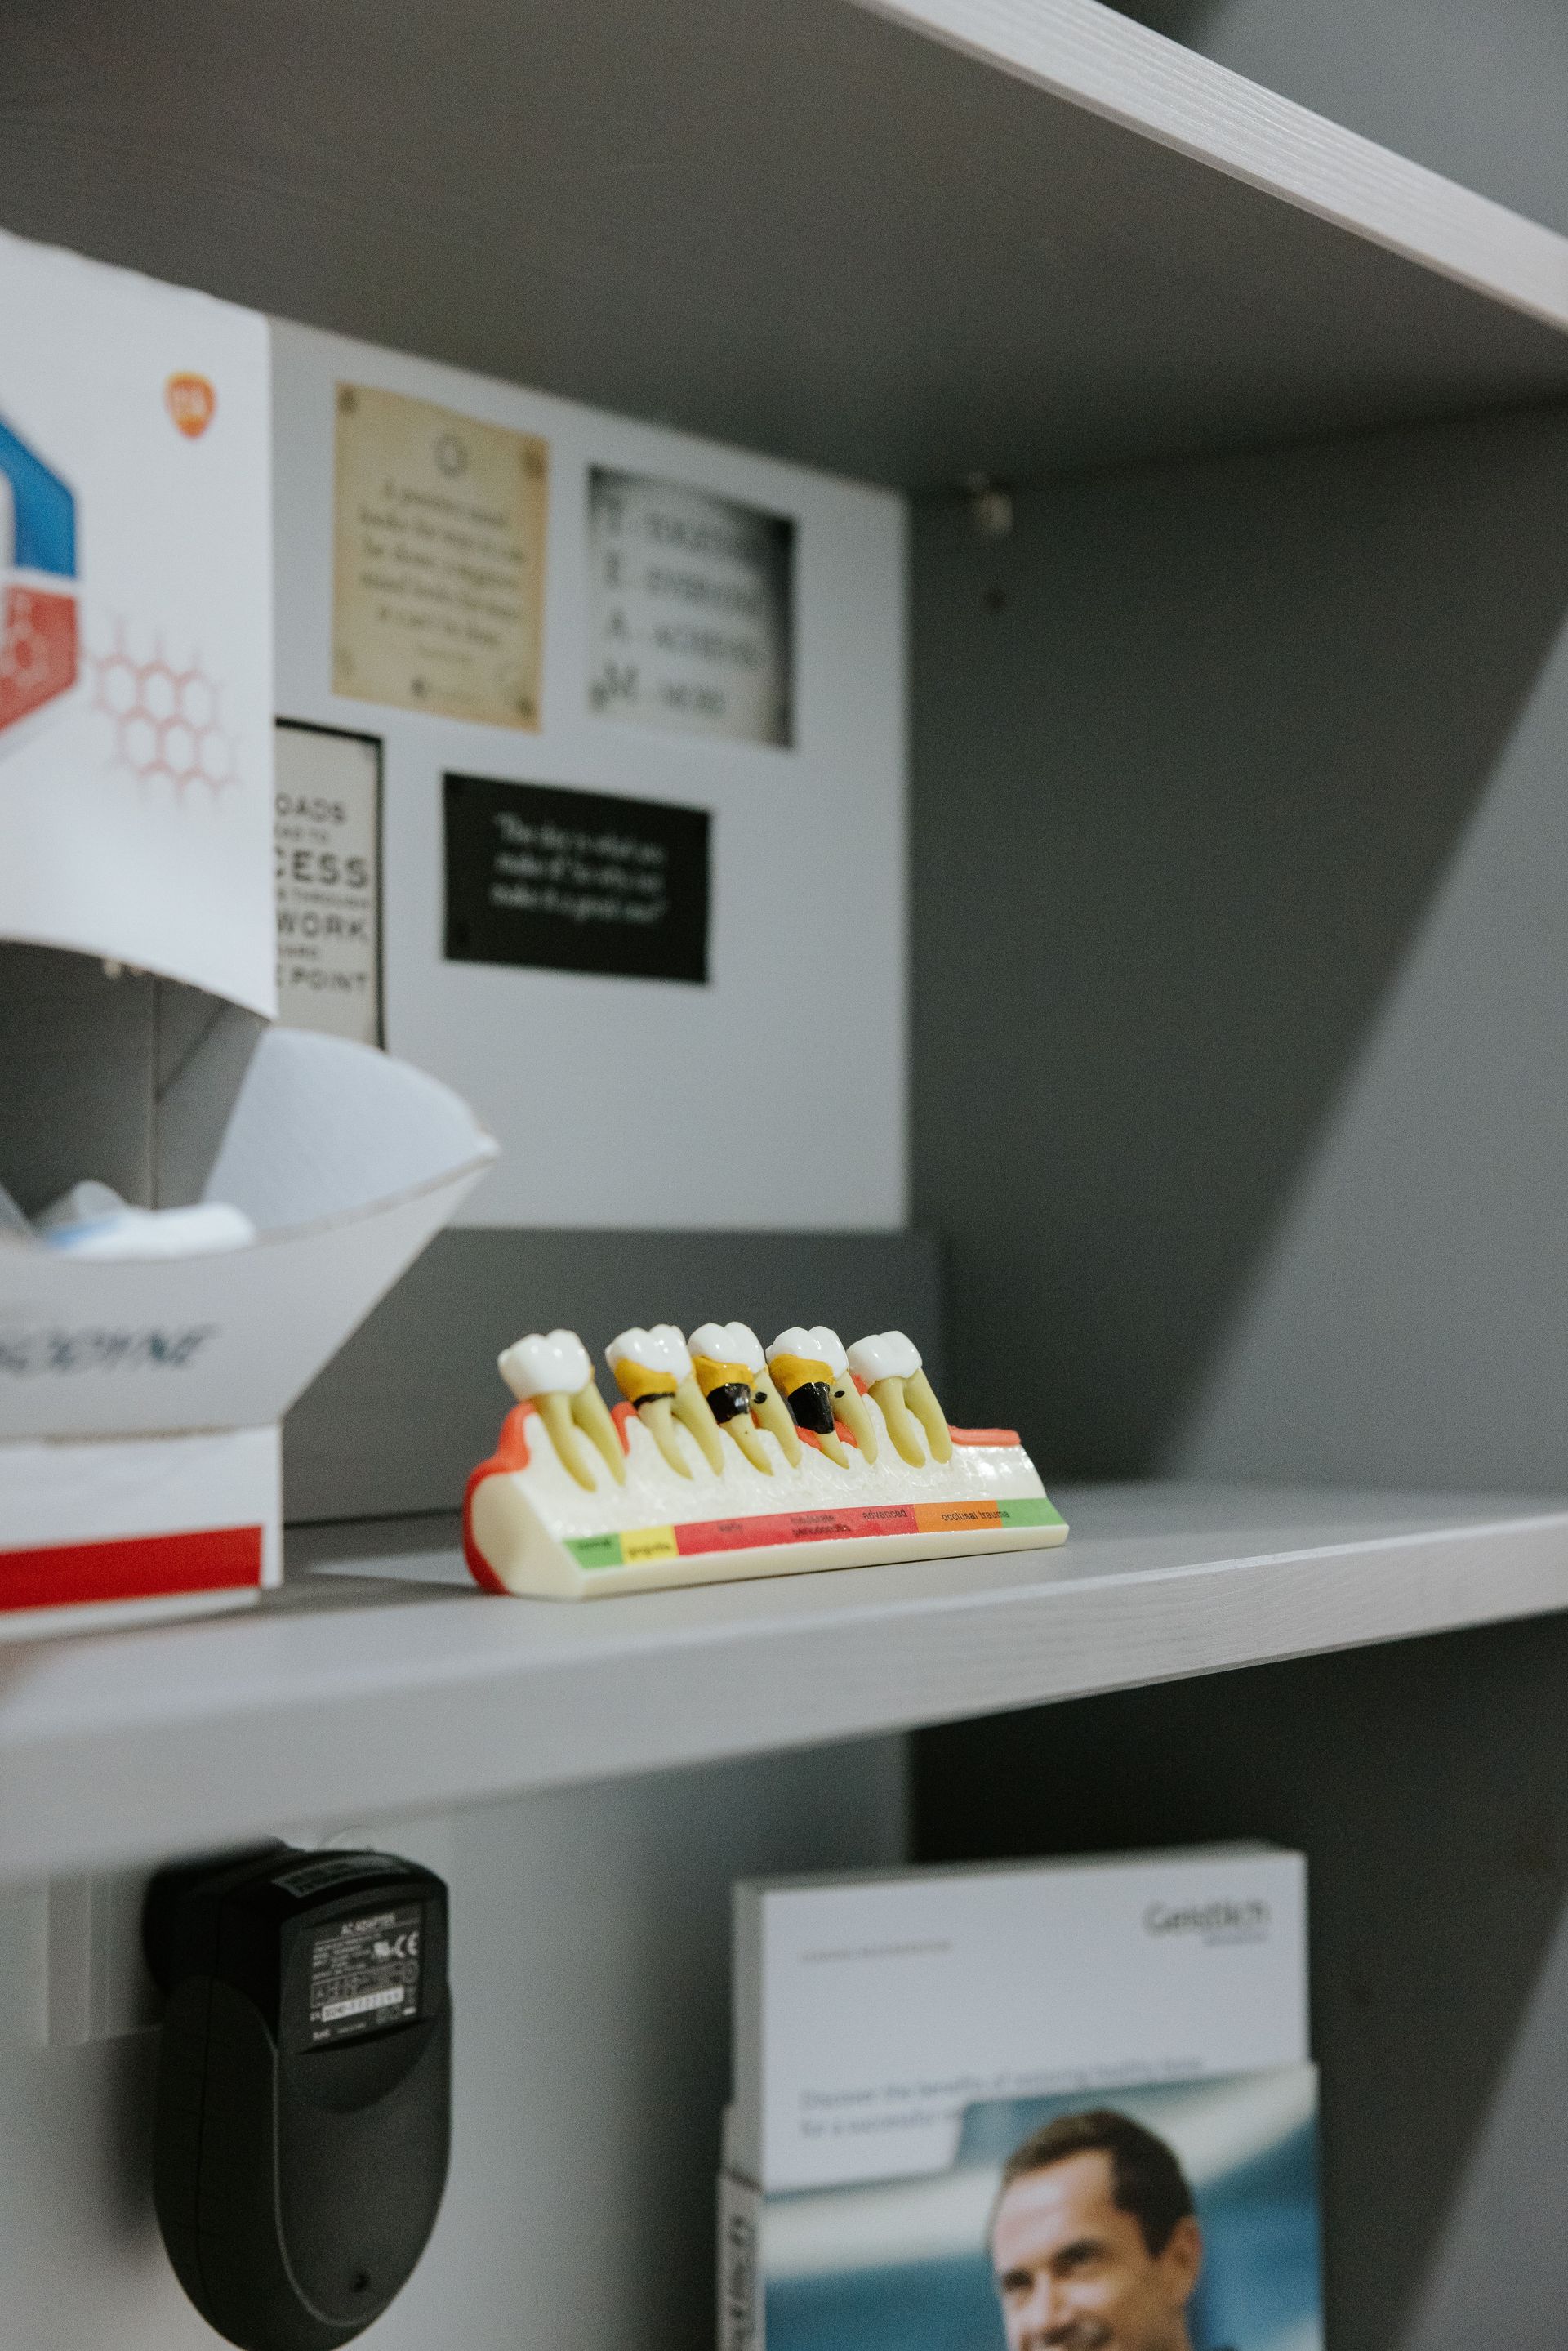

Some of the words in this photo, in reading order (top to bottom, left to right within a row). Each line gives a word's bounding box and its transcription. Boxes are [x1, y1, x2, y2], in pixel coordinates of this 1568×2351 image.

[862, 1509, 908, 1520] advanced
[942, 1510, 978, 1522] occlusal
[980, 1510, 1010, 1520] trauma
